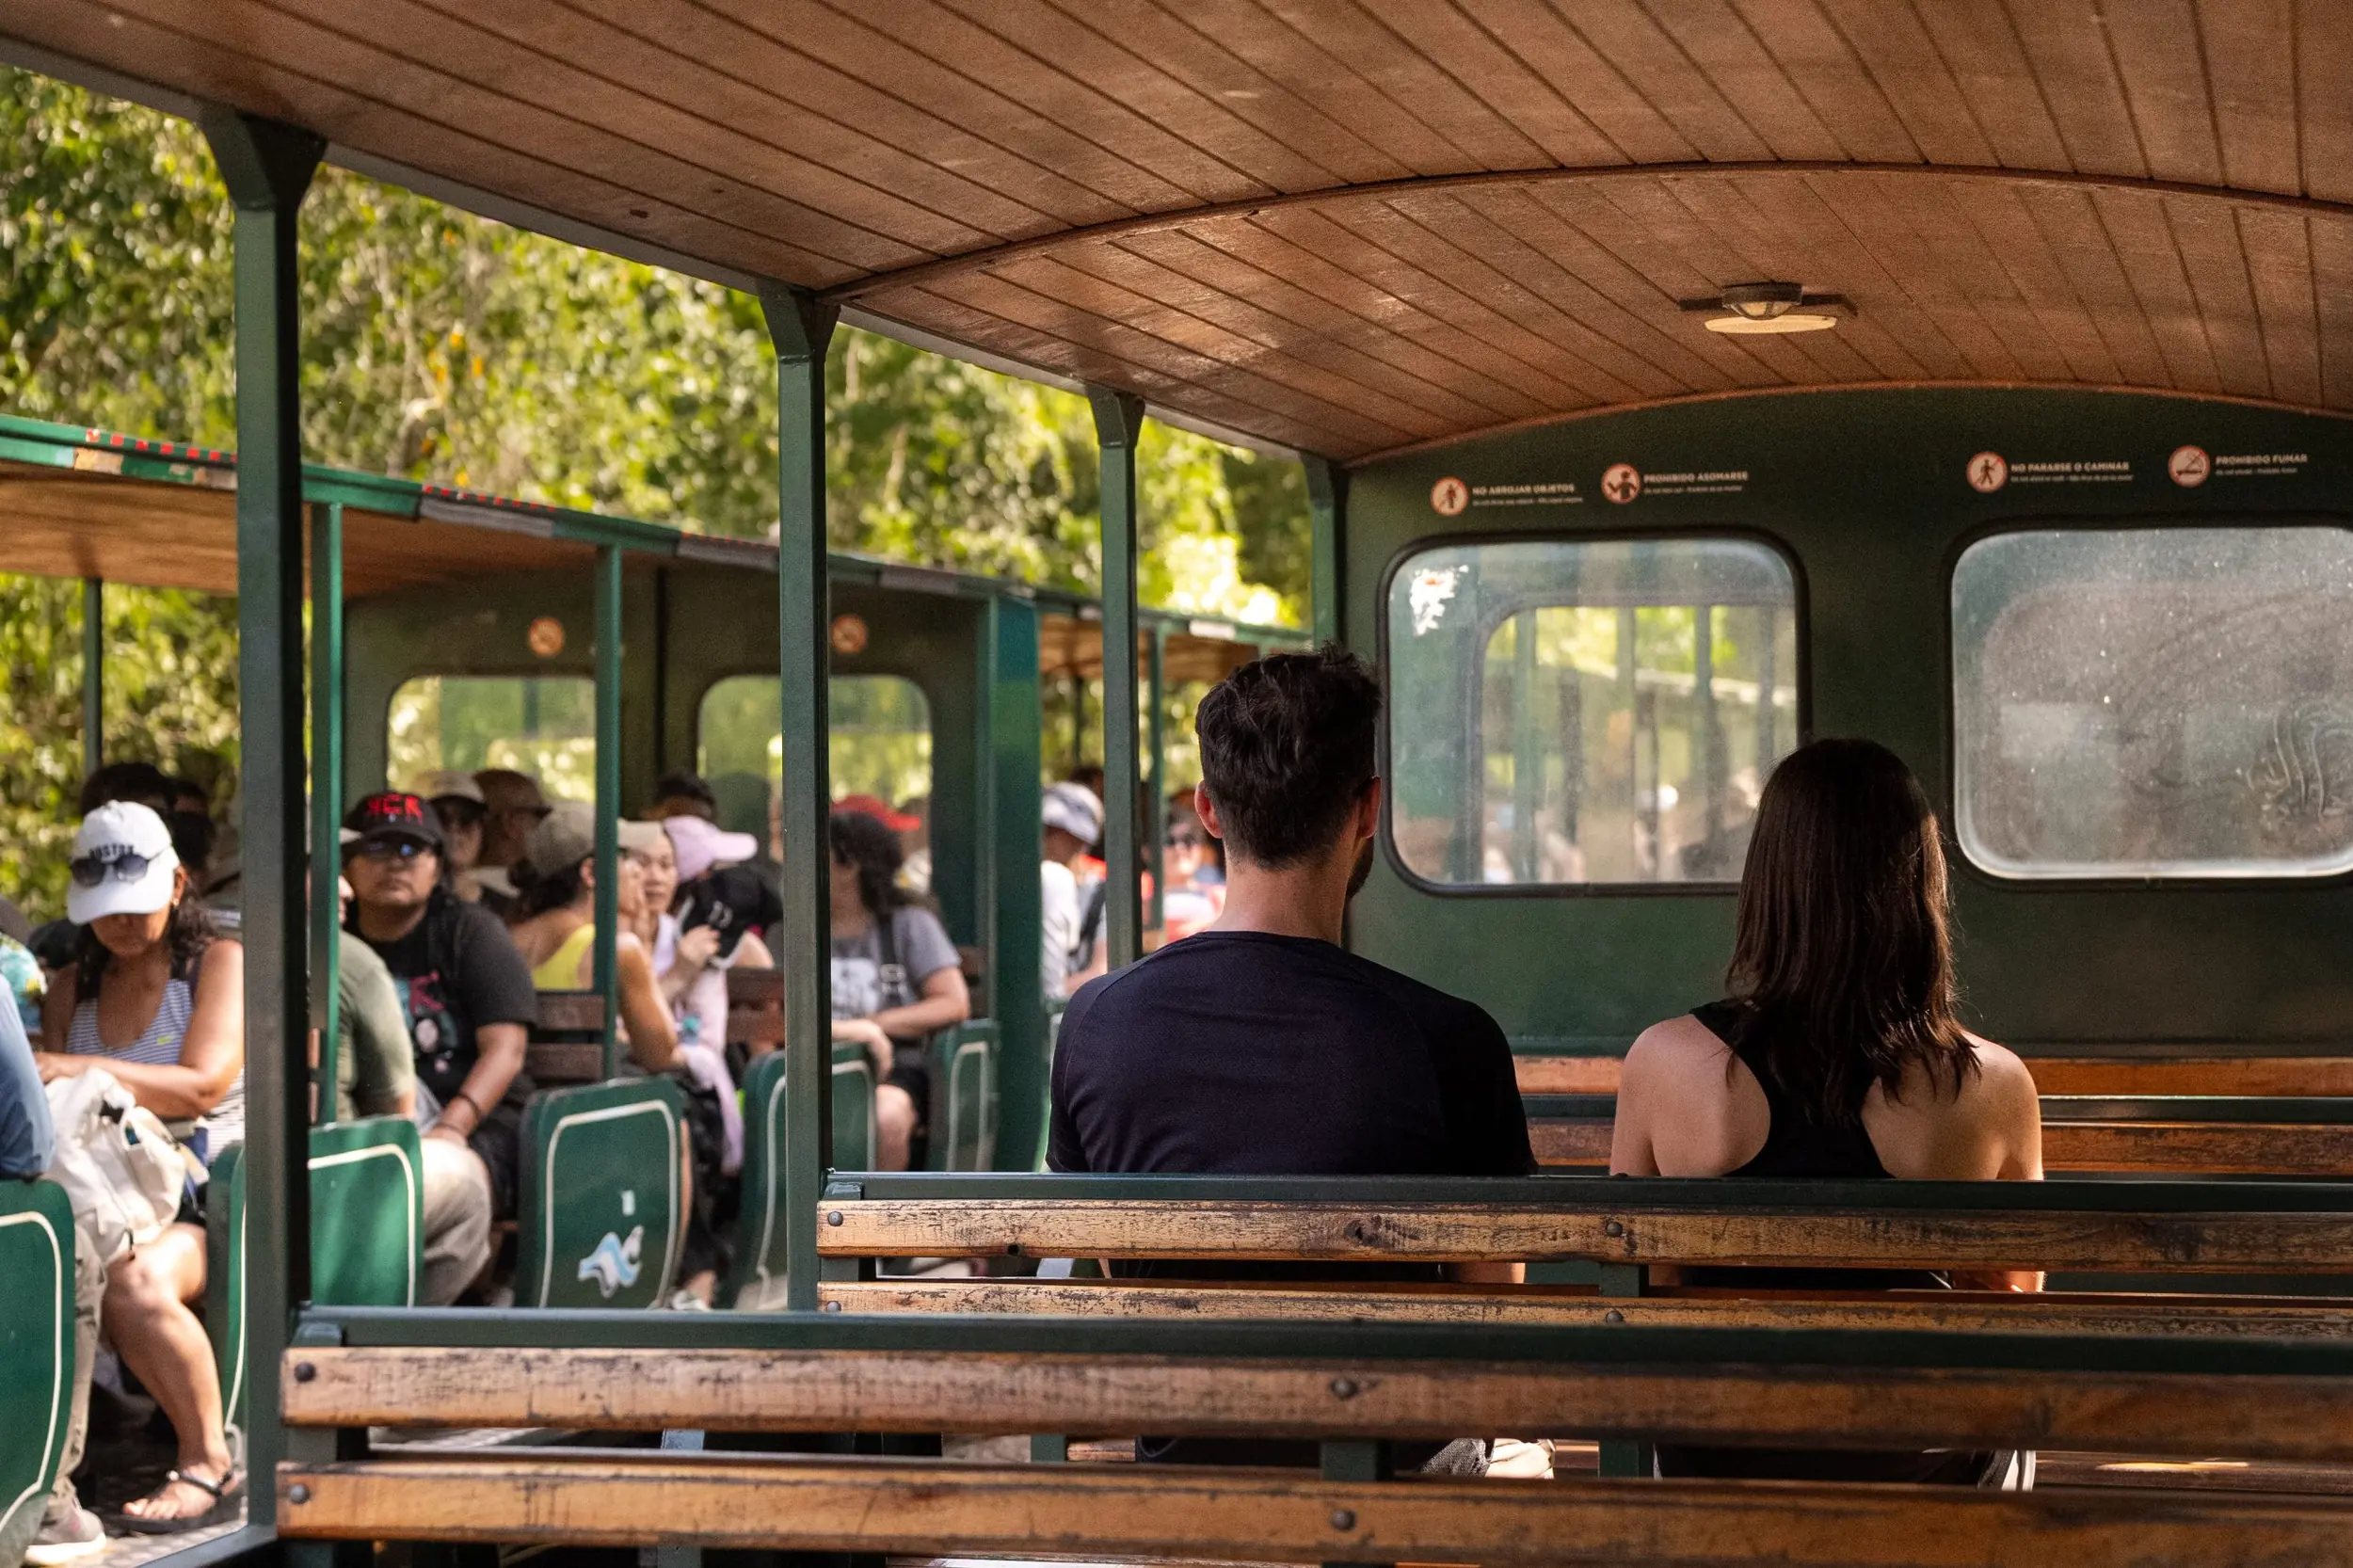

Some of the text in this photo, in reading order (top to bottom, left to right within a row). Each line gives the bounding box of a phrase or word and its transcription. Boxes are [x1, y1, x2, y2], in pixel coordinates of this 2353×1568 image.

[2216, 453, 2309, 465] PROHIBIDO FUMAR
[2010, 461, 2130, 472] NO PARARSE O CAMINAR
[1643, 471, 1749, 484] PROHIBIDO ASOMARSE
[1472, 483, 1576, 496] NO ARROJAR OBJETOS
